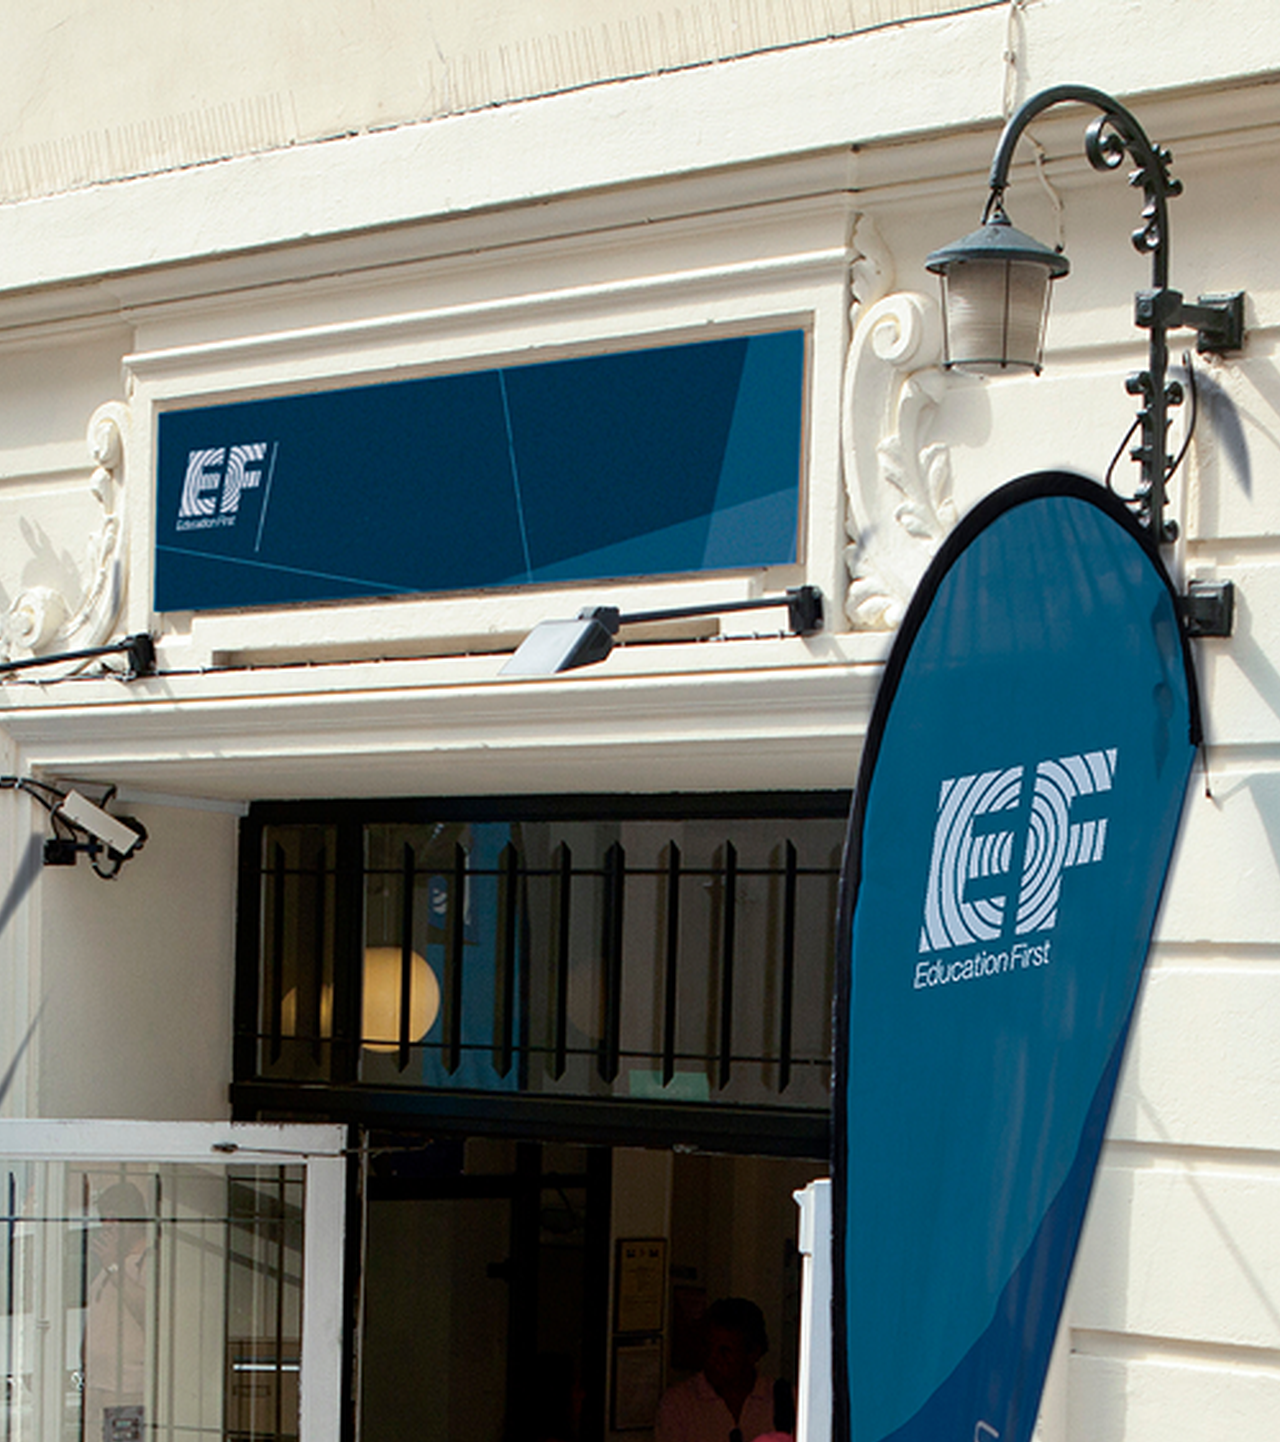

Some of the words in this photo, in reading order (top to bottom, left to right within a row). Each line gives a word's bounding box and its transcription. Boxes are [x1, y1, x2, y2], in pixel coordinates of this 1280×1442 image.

[179, 442, 267, 517] EF
[918, 747, 1118, 953] EF
[913, 950, 1009, 989] Education
[1009, 939, 1052, 969] First
